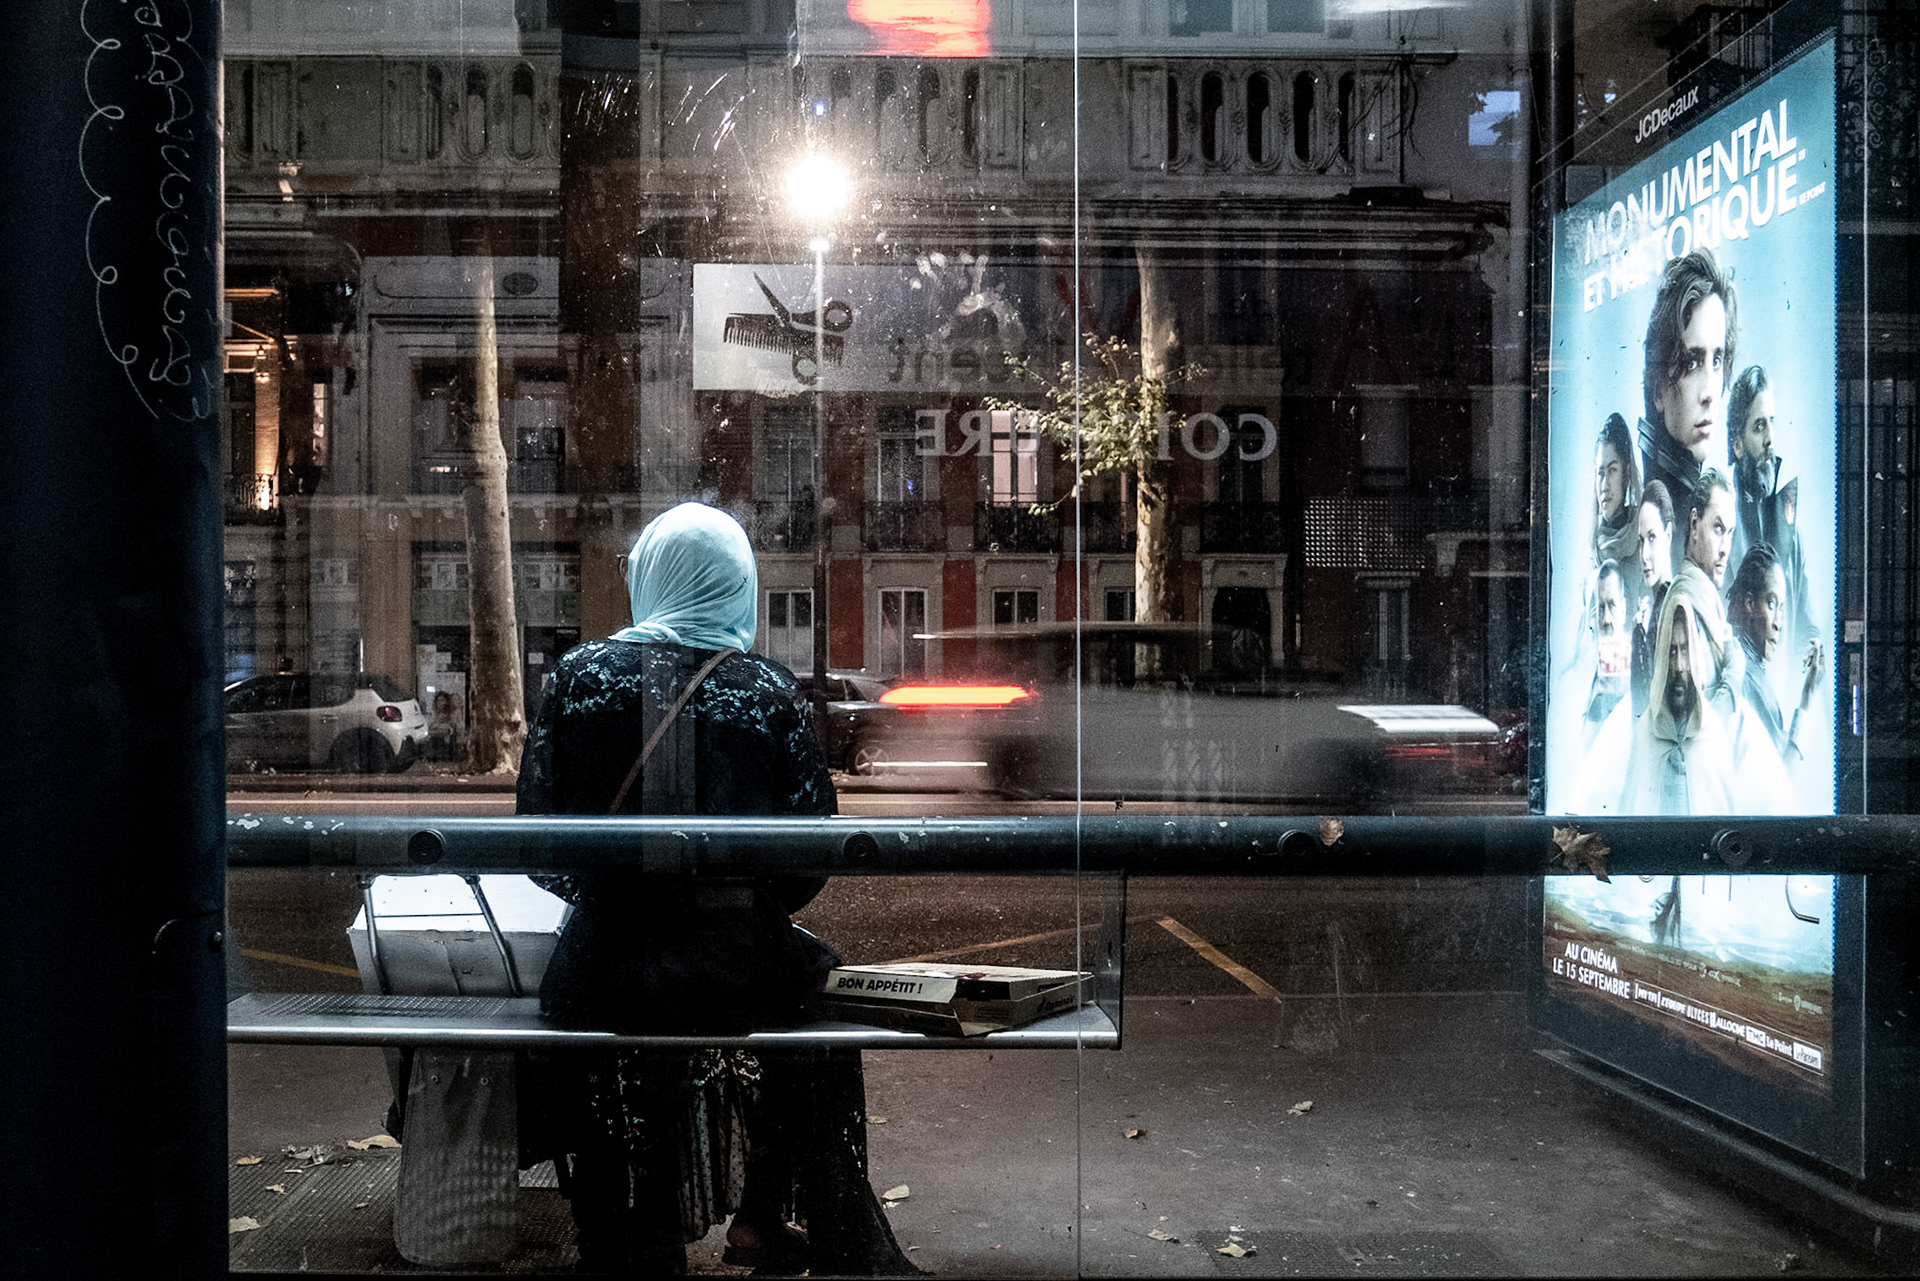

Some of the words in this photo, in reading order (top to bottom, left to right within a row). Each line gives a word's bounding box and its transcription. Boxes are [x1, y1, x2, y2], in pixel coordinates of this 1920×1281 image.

[1635, 86, 1700, 144] JCDecaux
[1584, 98, 1798, 265] MONUMENTAL
[1583, 270, 1606, 313] ET
[1552, 957, 1563, 975] LE
[1566, 961, 1577, 980] 15
[1577, 967, 1631, 999] SEPTEMBRE
[1564, 941, 1579, 961] AU
[1580, 947, 1619, 974] CINÉMA
[837, 977, 864, 991] BON
[866, 978, 916, 994] APPÉTIT
[916, 982, 922, 994] !
